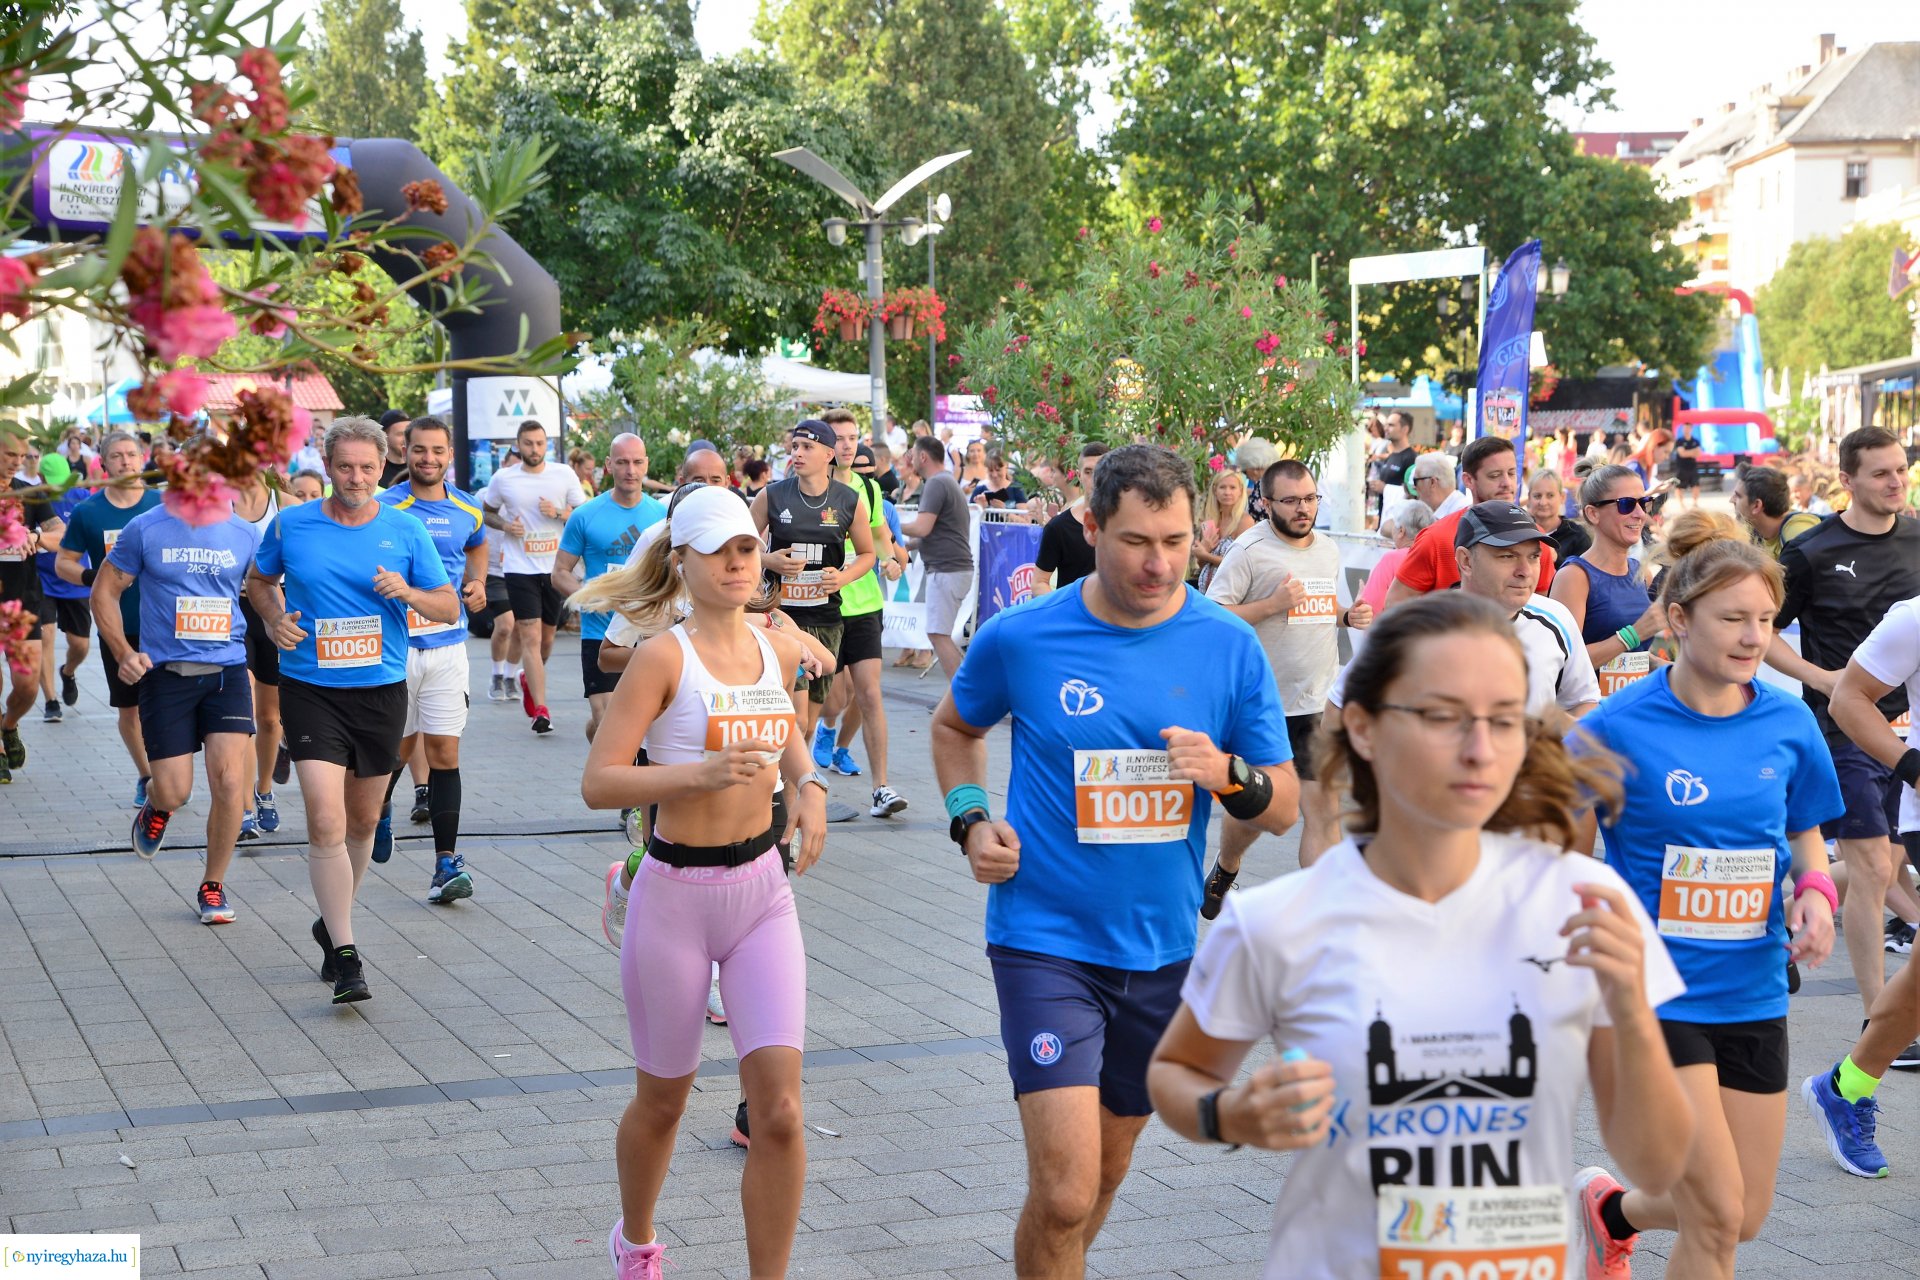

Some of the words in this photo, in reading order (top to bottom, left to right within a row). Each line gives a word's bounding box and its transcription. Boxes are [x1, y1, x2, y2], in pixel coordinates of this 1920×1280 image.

[1497, 340, 1530, 366] GLO
[528, 541, 555, 552] 10071
[786, 585, 825, 599] 10124
[1015, 570, 1033, 592] GLO
[180, 615, 228, 632] 10072
[321, 637, 378, 658] 10060
[718, 718, 789, 749] 10140
[1125, 764, 1168, 774] FUTÓFESZ
[1126, 754, 1167, 764] II.NYÍREG
[1088, 789, 1185, 823] 10012
[1674, 886, 1765, 919] 10109
[1367, 1103, 1532, 1138] KRONES
[1368, 1140, 1521, 1198] RUN
